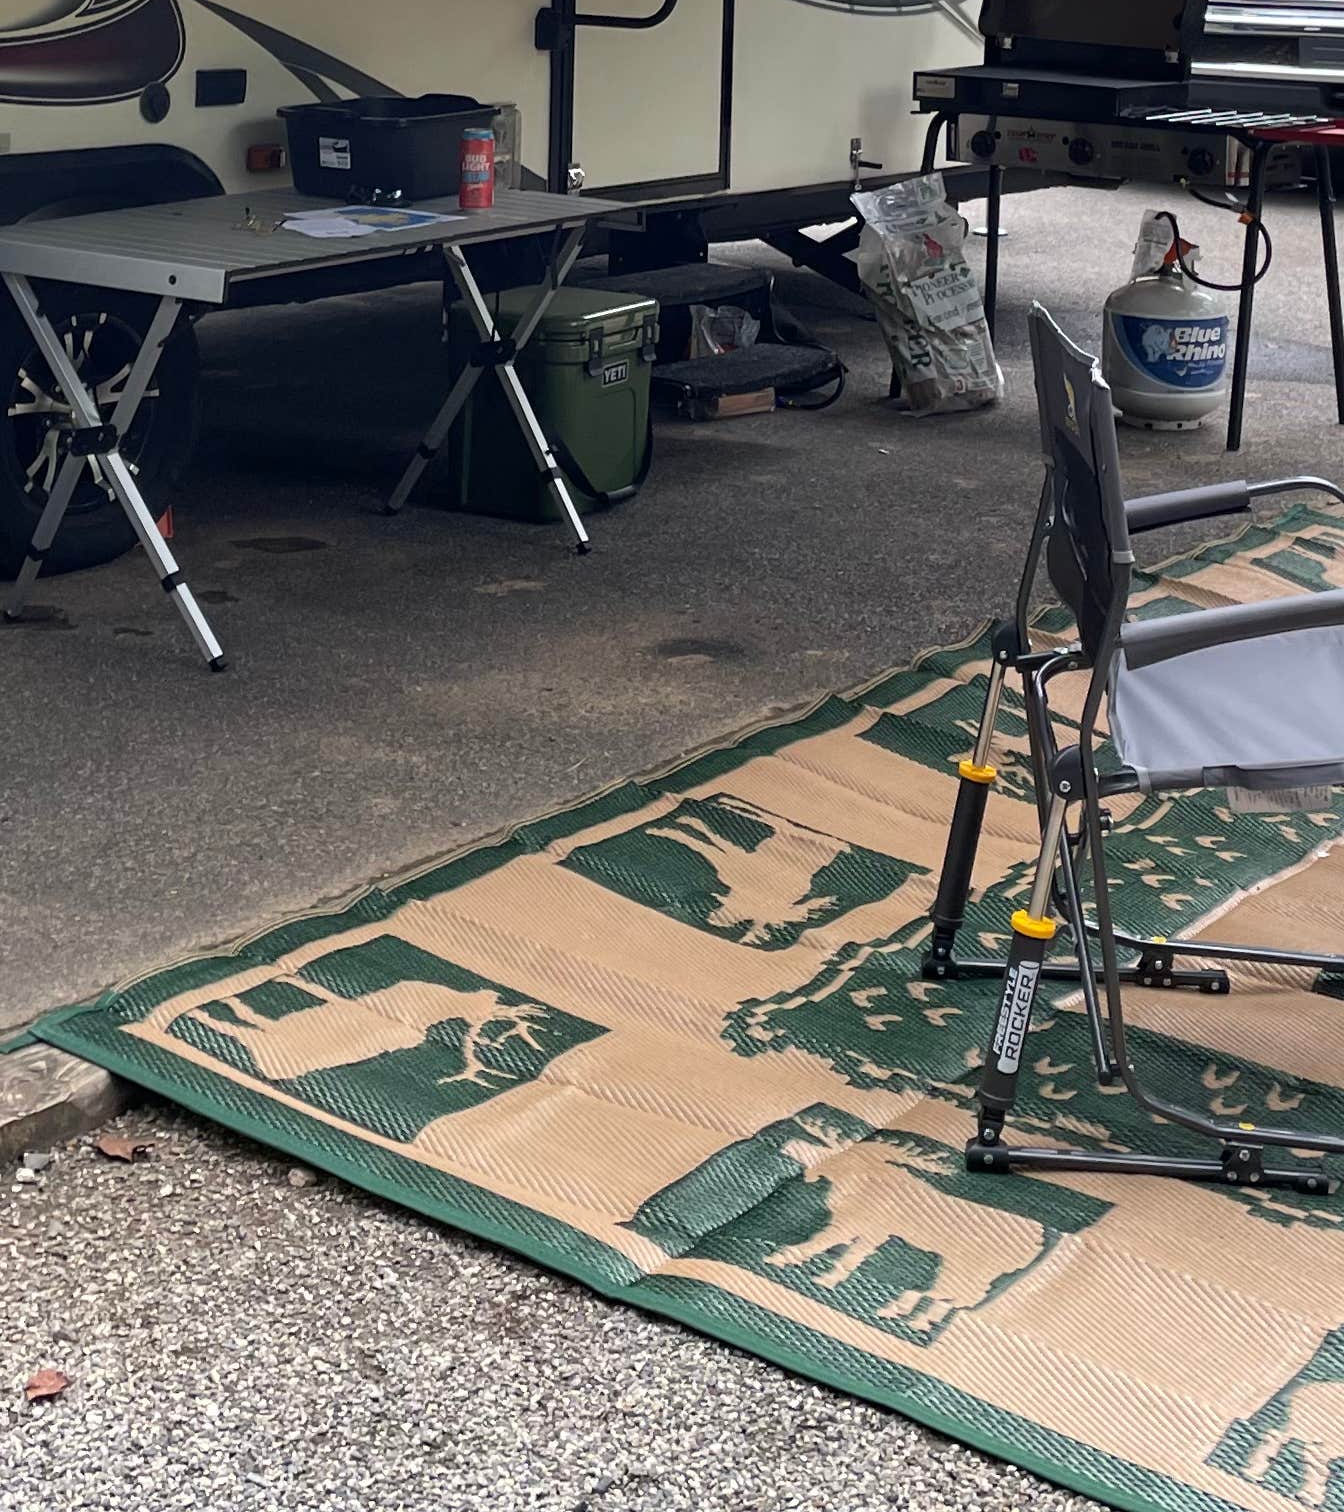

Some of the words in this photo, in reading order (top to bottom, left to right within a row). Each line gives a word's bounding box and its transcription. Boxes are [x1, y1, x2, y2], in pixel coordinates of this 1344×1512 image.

[464, 154, 488, 163] BUD
[1174, 326, 1221, 343] Blue
[1166, 343, 1226, 361] Rhino
[604, 364, 626, 383] YETI
[993, 966, 1018, 1056] FREESTYLE
[1005, 974, 1034, 1061] ROCKER
